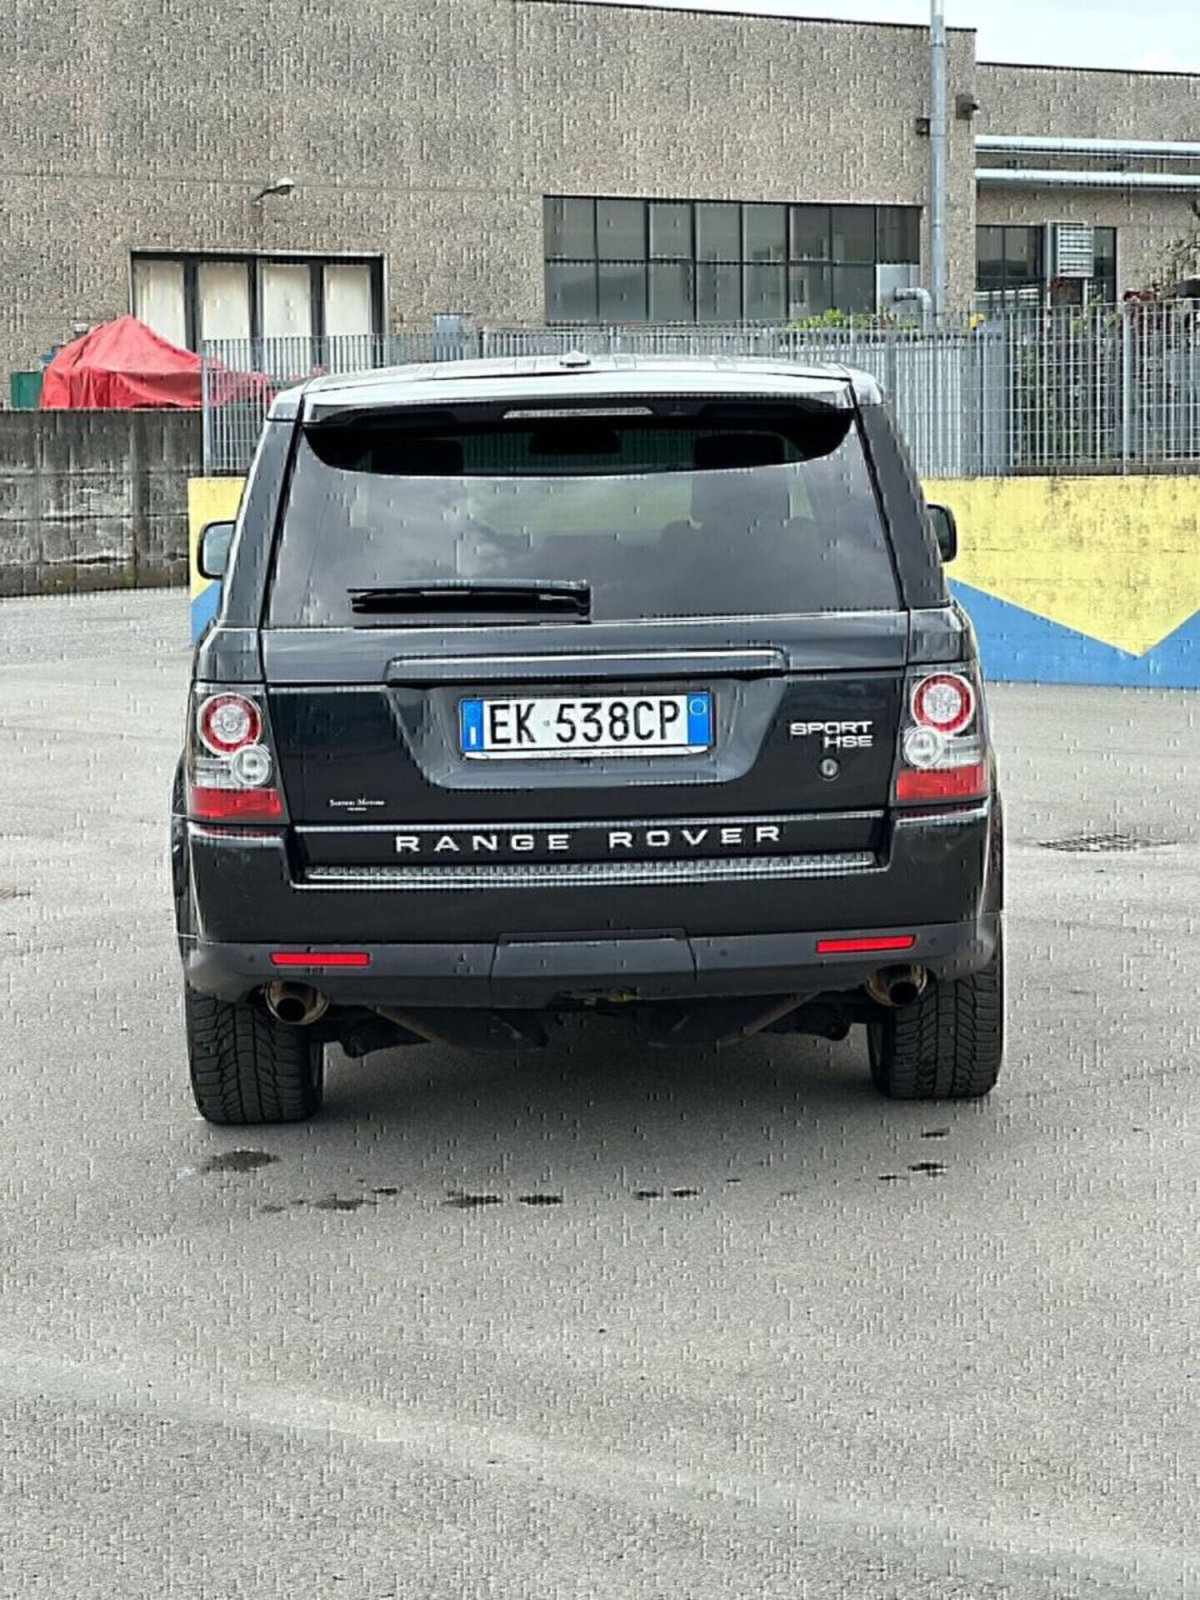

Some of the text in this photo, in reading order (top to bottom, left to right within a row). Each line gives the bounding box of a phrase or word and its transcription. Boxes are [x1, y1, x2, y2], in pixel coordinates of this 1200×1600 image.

[488, 700, 681, 745] EK 538CP
[789, 720, 873, 736] SPORT
[823, 735, 873, 749] HSE
[395, 826, 781, 852] RANGE ROVER
